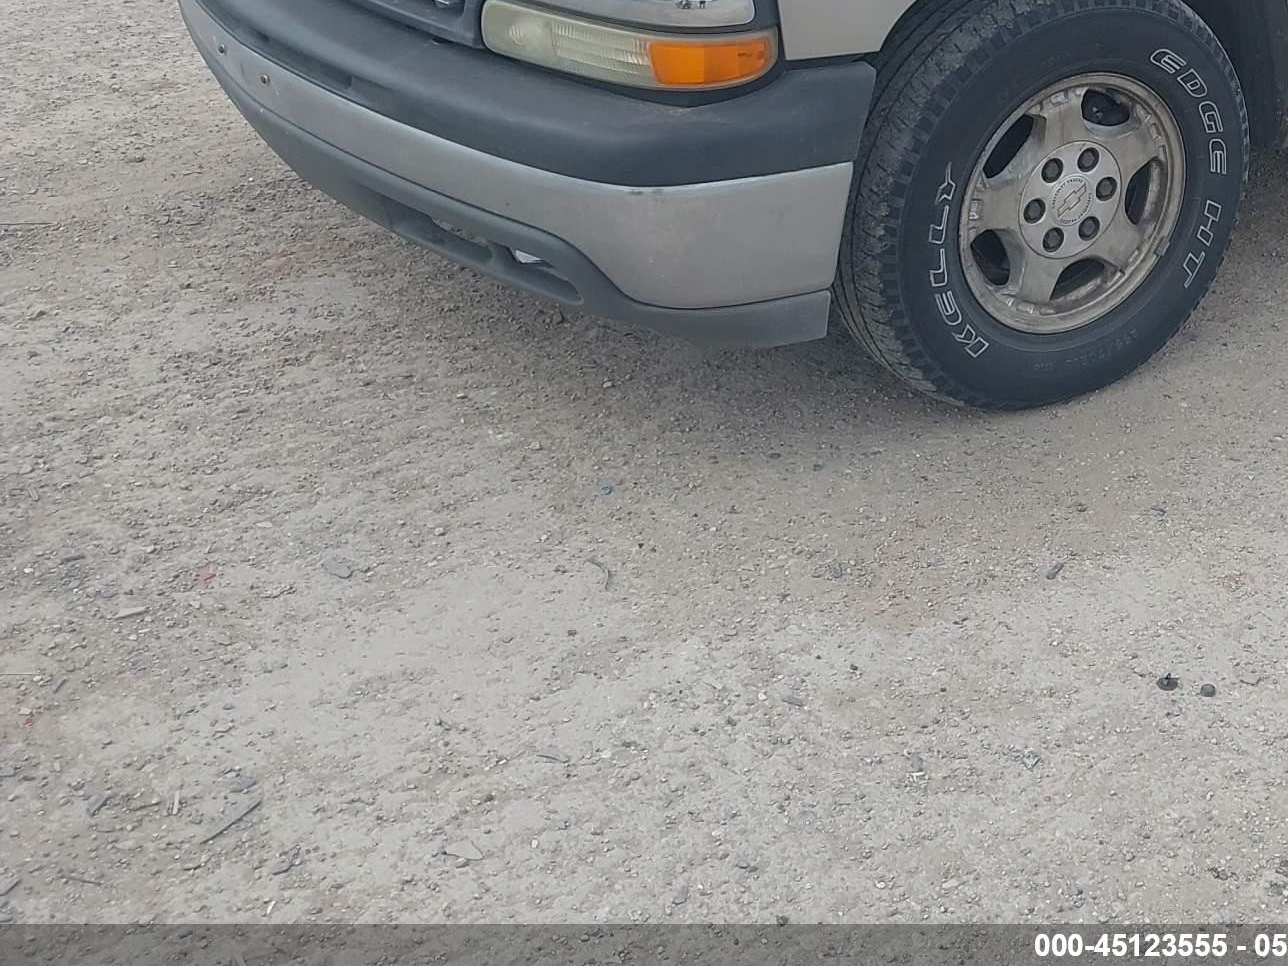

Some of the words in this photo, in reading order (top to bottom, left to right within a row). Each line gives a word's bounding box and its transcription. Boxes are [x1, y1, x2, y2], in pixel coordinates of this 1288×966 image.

[1150, 47, 1228, 175] EDGE
[928, 161, 991, 360] KELLY
[1182, 198, 1223, 289] HT
